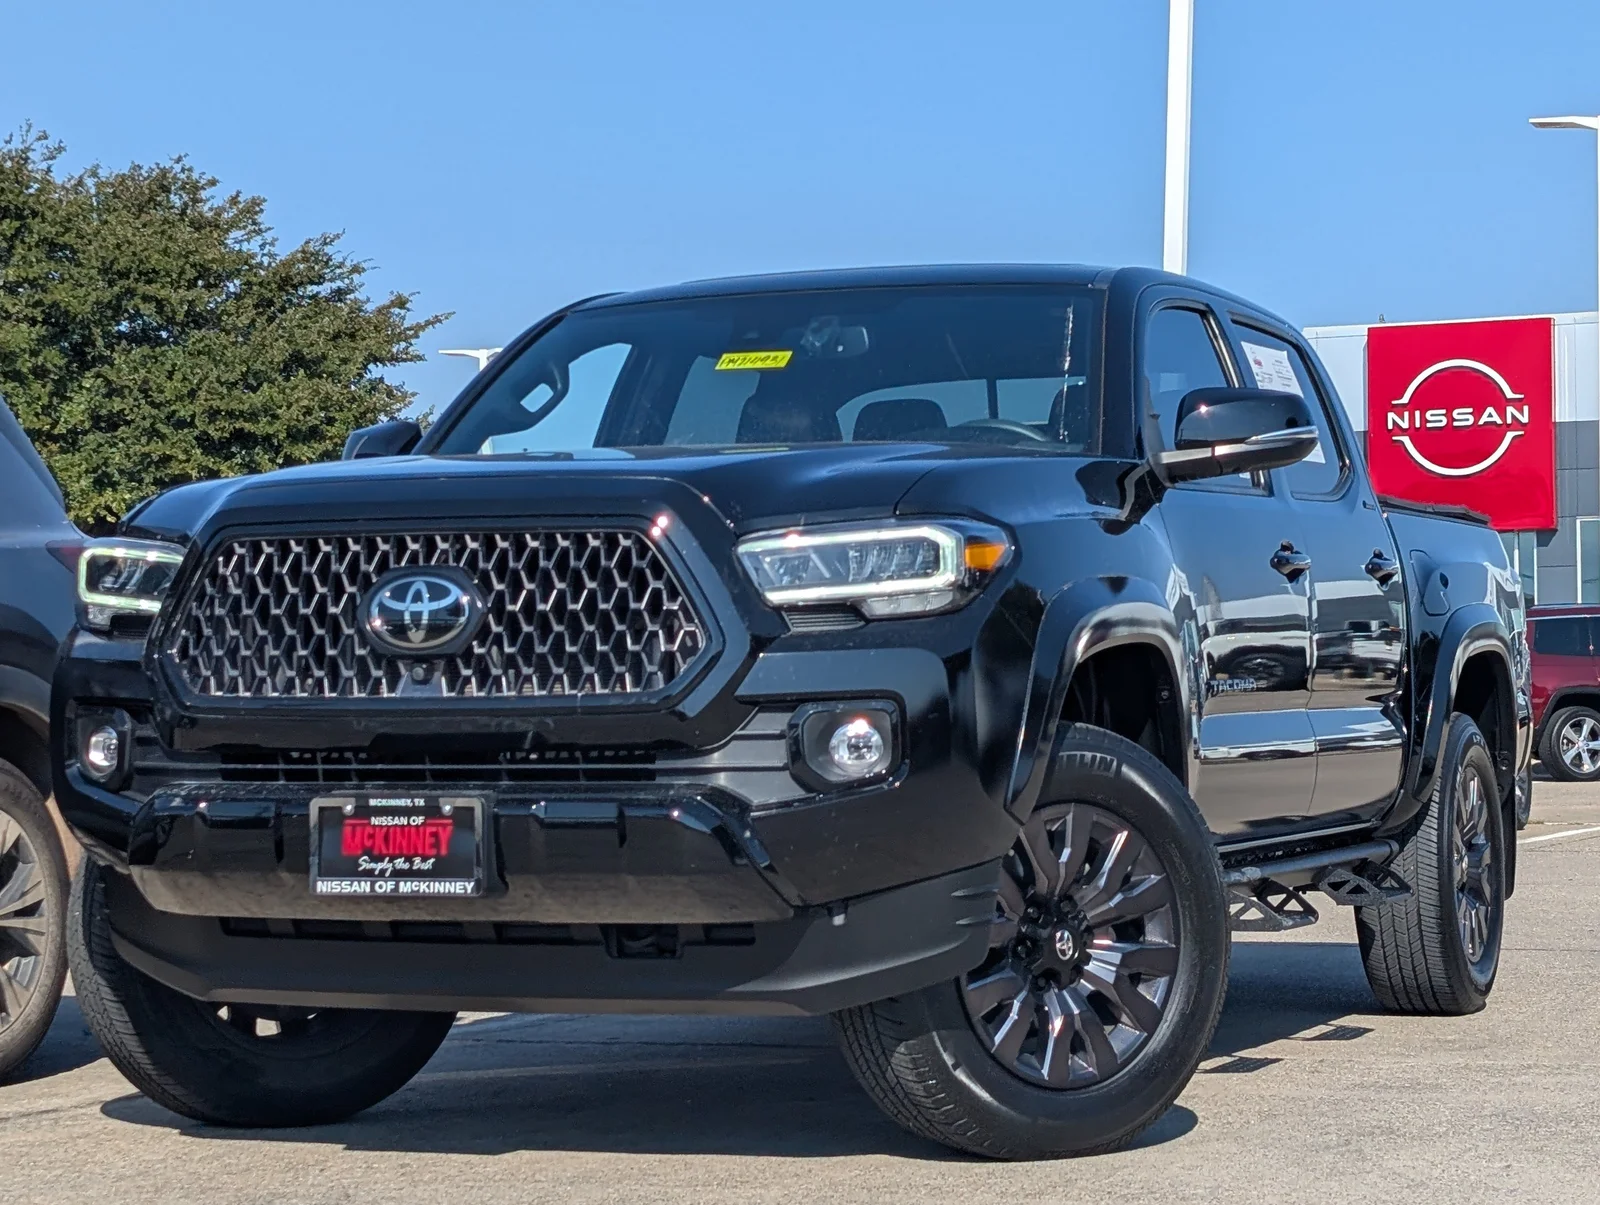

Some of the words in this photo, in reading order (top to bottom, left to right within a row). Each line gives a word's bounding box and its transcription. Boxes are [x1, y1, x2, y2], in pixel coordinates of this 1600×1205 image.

[1387, 405, 1529, 430] NISSAN
[1211, 677, 1257, 690] TACOMA
[414, 798, 425, 806] TX
[370, 816, 408, 826] NISSAN
[409, 816, 426, 825] OF
[357, 855, 394, 877] Simply
[394, 857, 410, 870] the
[412, 856, 436, 870] Best
[316, 881, 371, 894] NISSAN
[374, 881, 396, 893] OF
